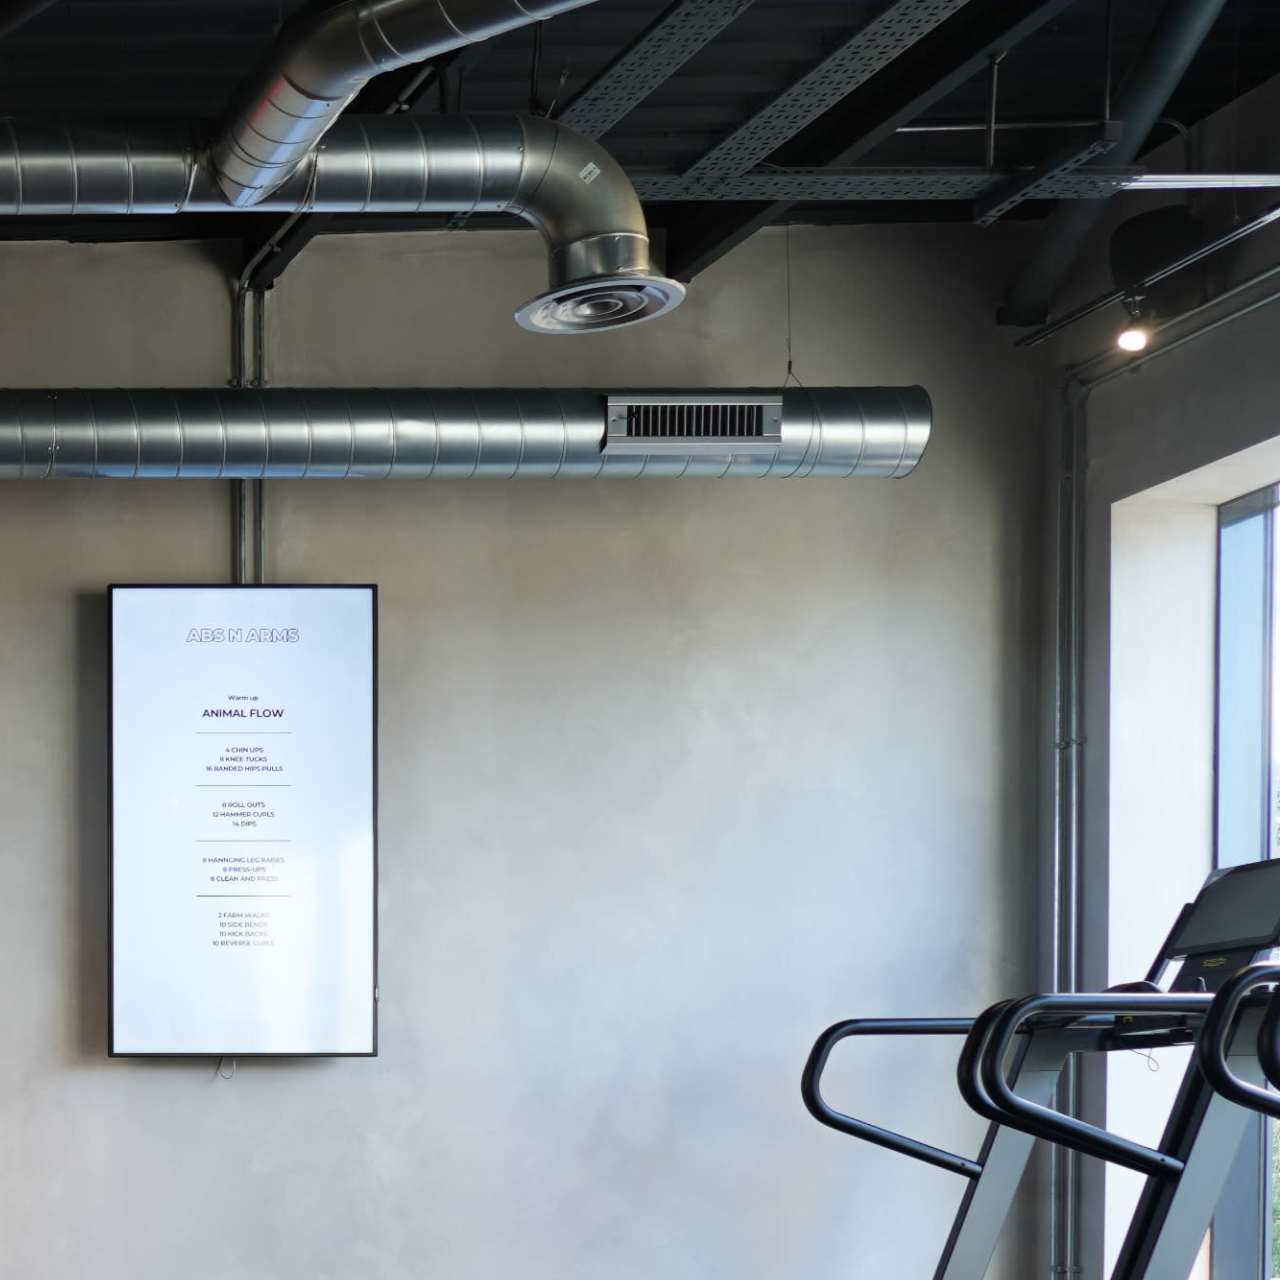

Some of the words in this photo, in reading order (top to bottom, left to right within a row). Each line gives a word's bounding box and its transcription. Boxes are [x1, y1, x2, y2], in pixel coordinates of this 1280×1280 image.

[186, 628, 225, 643] ABS
[228, 628, 243, 643] N
[245, 628, 300, 643] ARMS
[202, 709, 247, 718] ANIMAL
[250, 709, 284, 718] FLOW
